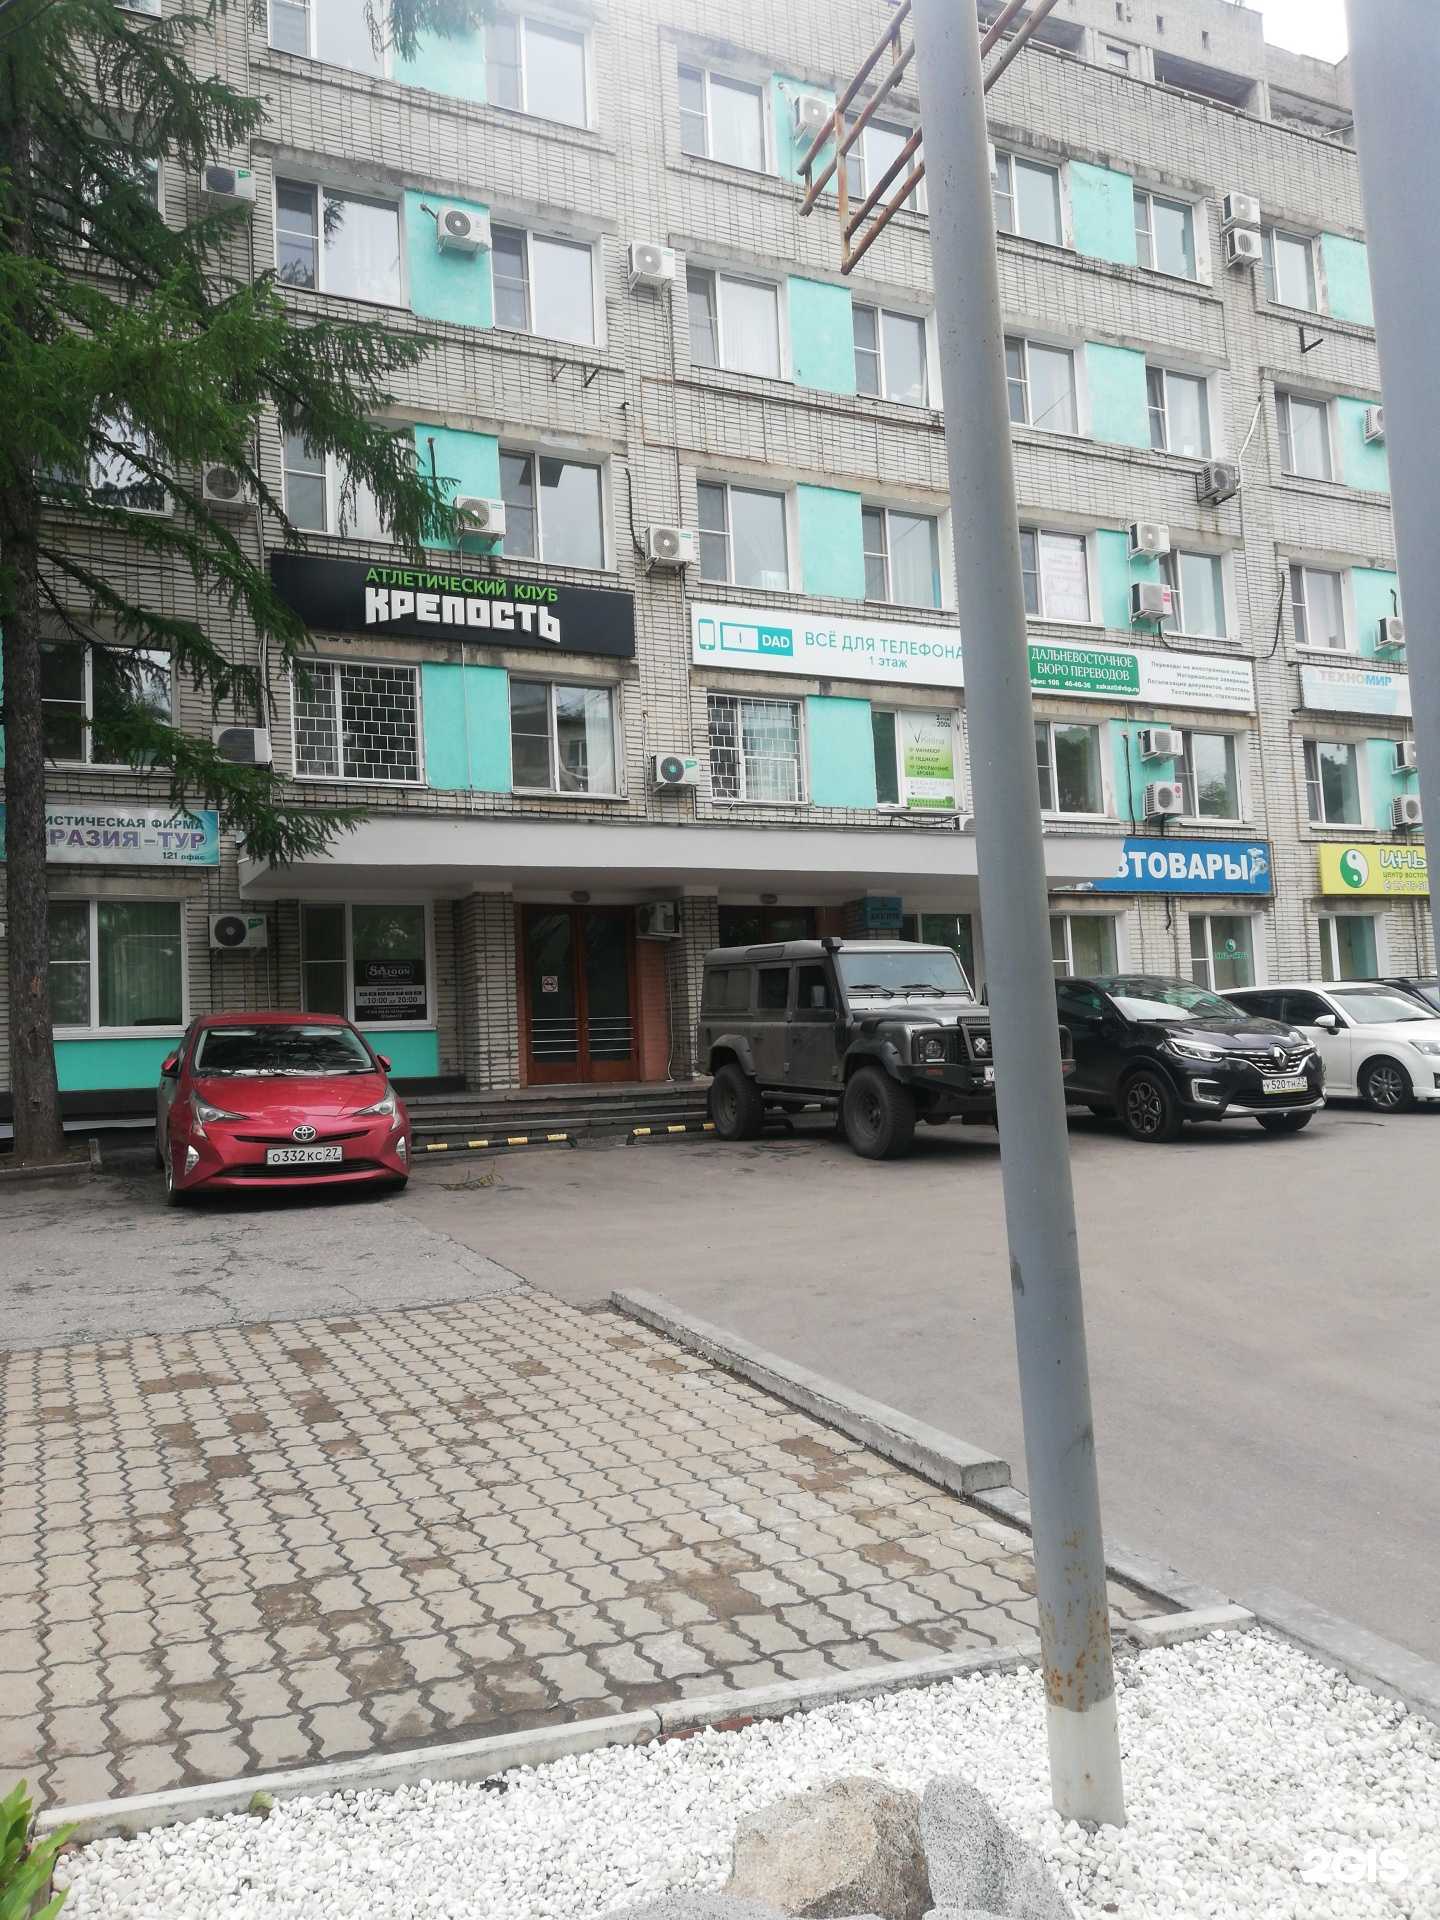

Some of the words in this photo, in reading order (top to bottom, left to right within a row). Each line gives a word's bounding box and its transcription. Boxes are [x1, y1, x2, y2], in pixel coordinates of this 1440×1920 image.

[366, 567, 507, 598] АТЛЕТИЧЕСКИЙ
[514, 584, 558, 602] КЛУБ
[365, 587, 561, 643] КРЕПОСТЬ
[762, 634, 790, 648] DAD
[805, 630, 836, 648] ВСЁ
[841, 635, 875, 652] ДЛЯ
[869, 655, 874, 666] 1
[878, 656, 908, 669] этаж
[1032, 648, 1133, 668] ДАЛЬНЕВОСТОЧНОЕ
[1037, 662, 1069, 676] БЮРО
[1070, 665, 1130, 681] ПЕРЕВОДОВ
[1320, 671, 1392, 687] ТЕХНОМИР
[46, 815, 146, 828] ИСТИЧЕСКАЯ
[151, 818, 205, 830] ФИРМА
[162, 851, 178, 860] 121
